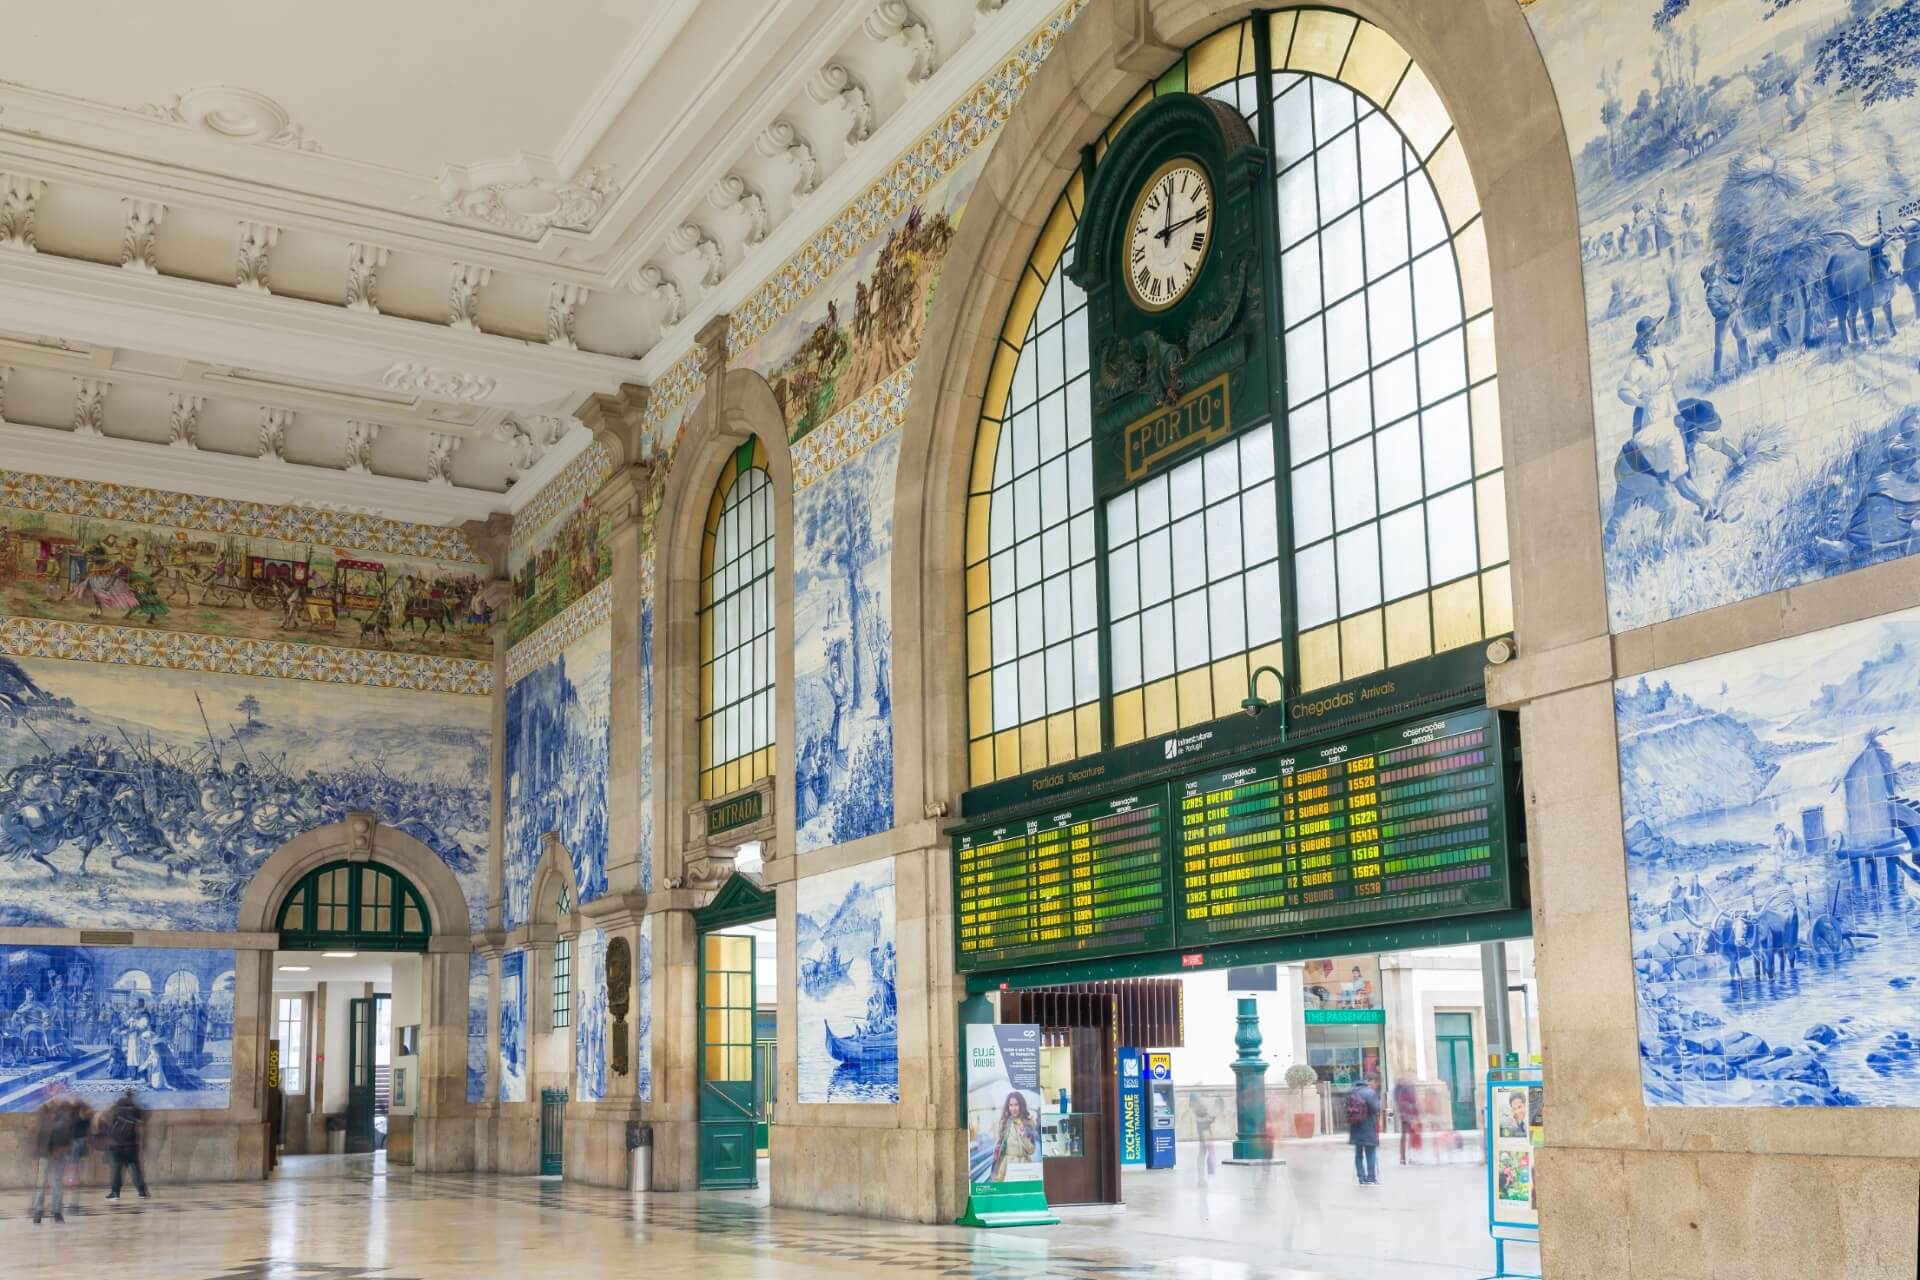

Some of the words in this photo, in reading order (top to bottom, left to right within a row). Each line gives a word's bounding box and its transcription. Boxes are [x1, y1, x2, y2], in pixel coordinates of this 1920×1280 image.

[1141, 394, 1211, 458] PORTO
[1292, 692, 1355, 719] Chegadas
[1360, 681, 1395, 701] Arrivals
[1032, 774, 1064, 791] Partidas
[1183, 796, 1204, 810] 12H25
[1297, 767, 1328, 785] SUBURB
[1348, 756, 1375, 773] 15622
[1298, 784, 1329, 802] SUBURB
[712, 799, 759, 830] ENTRADA
[1299, 802, 1329, 819] SUBURB
[1300, 818, 1330, 836] SUBURB
[1350, 809, 1377, 826] 15224
[1300, 836, 1331, 853] SUBURB
[1301, 853, 1332, 870] SUBURB
[1211, 886, 1238, 900] AVEIRO
[1302, 871, 1333, 887] SUBURB
[1353, 863, 1380, 879] 15624
[1303, 888, 1334, 904] SUBURB
[1326, 1010, 1378, 1022] PASSENGER
[269, 1050, 279, 1088] CACIFOS
[1124, 1094, 1135, 1160] EXCHANGE
